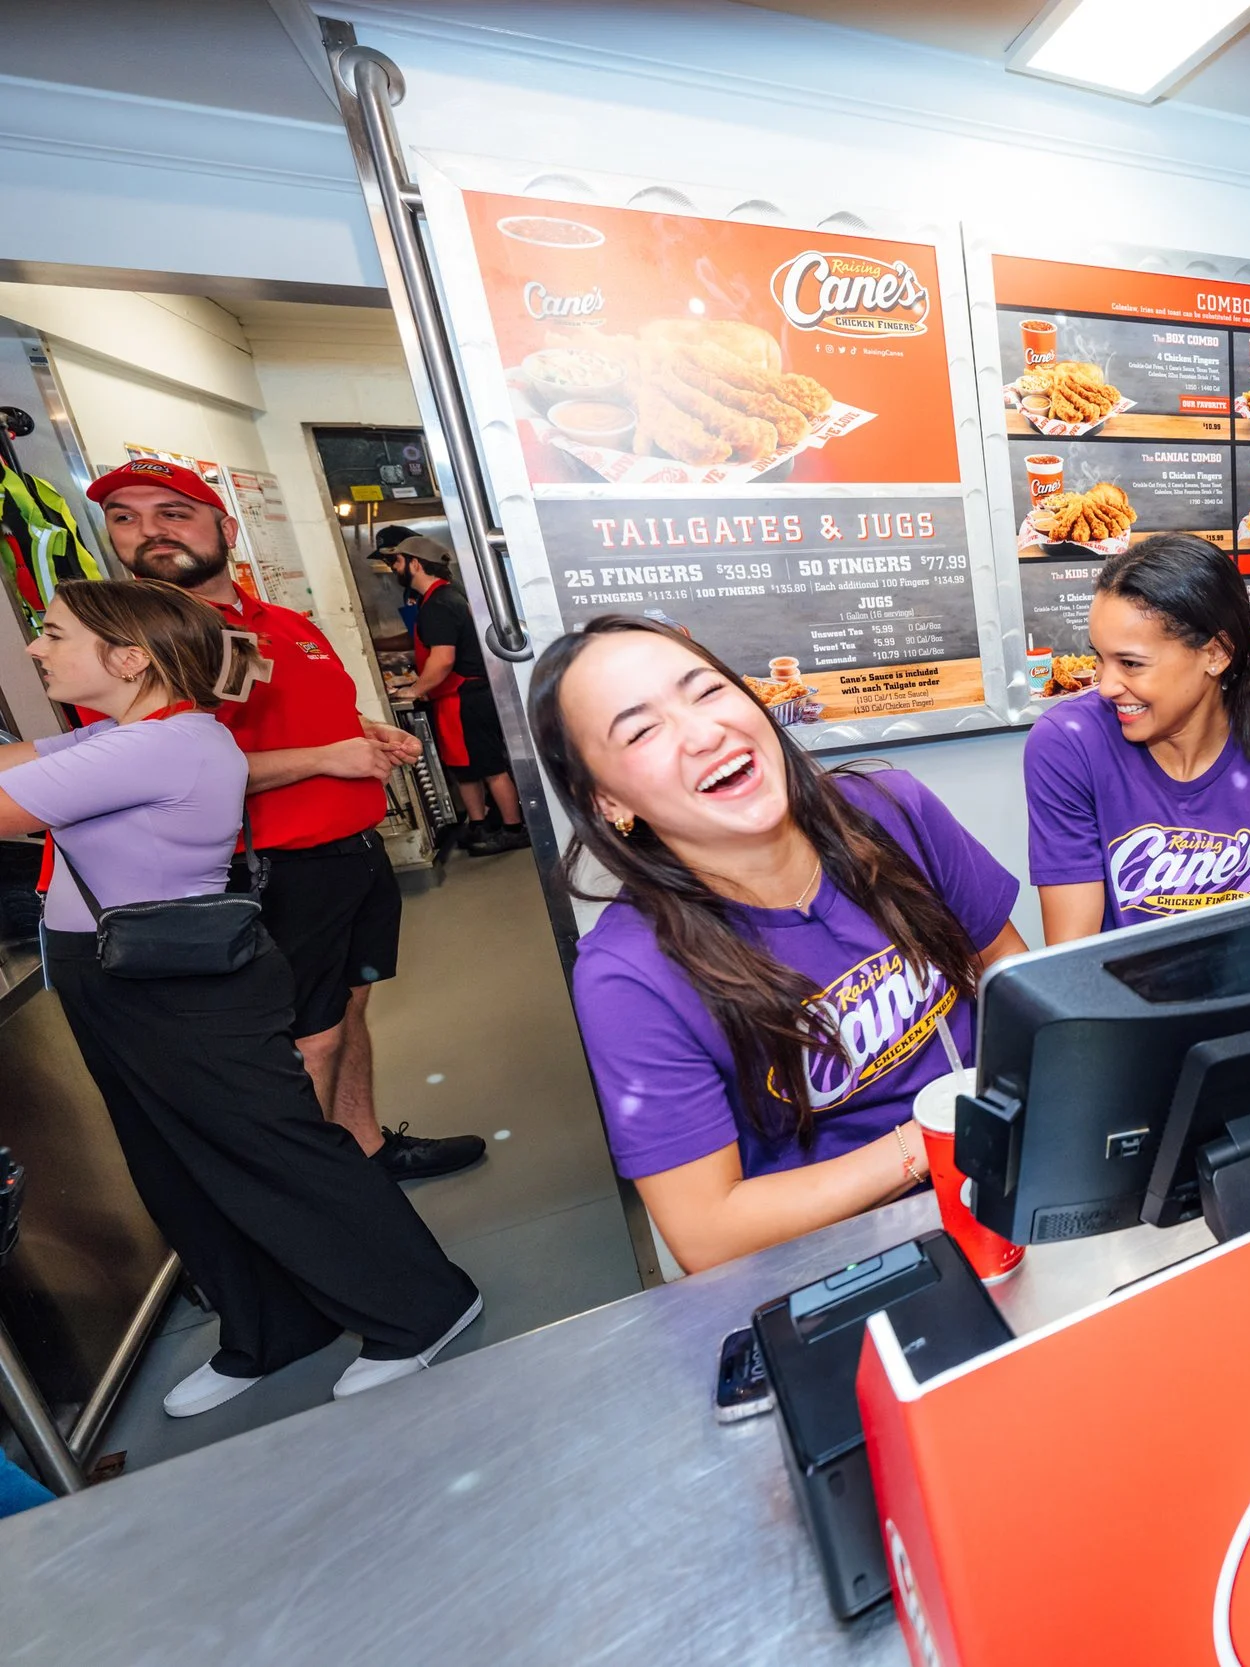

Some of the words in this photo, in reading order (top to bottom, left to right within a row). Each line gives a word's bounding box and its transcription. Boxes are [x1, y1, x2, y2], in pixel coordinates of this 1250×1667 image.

[832, 259, 881, 278] Raising
[783, 252, 926, 328] Cane's
[523, 281, 605, 320] Cane's
[1155, 307, 1166, 315] and
[1193, 310, 1201, 319] be
[835, 316, 874, 329] CHICKEN
[878, 320, 917, 332] FINGERS
[1152, 334, 1165, 342] The
[1165, 332, 1185, 345] BOX
[1187, 333, 1219, 347] COMBO
[1025, 348, 1056, 364] Cane's
[1157, 352, 1162, 361] 4
[1164, 352, 1192, 363] Chicken
[1193, 354, 1220, 366] Fingers
[1182, 401, 1196, 409] OUR
[1197, 401, 1227, 410] FAVORITE
[1141, 454, 1154, 462] The
[1154, 452, 1189, 463] CANIAC
[1191, 452, 1222, 463] COMBO
[1169, 471, 1196, 480] Chicken
[1197, 472, 1222, 482] Fingers
[1031, 479, 1061, 496] Cane's
[592, 515, 803, 549] TAILGATES
[820, 514, 844, 541] &
[857, 512, 936, 540] JUGS
[799, 559, 824, 577] 50
[828, 556, 912, 576] FINGERS
[920, 555, 967, 571] $77.99
[1051, 572, 1064, 580] The
[1064, 568, 1088, 579] KIDS
[564, 569, 595, 588] 25
[600, 564, 704, 587] FINGERS
[716, 563, 773, 581] $39.99
[815, 582, 836, 592] Each
[838, 580, 880, 590] additional
[881, 578, 898, 588] 100
[900, 577, 930, 588] Fingers
[934, 575, 965, 585] $134.99
[572, 595, 588, 605] 75
[591, 592, 644, 604] FINGERS
[648, 589, 688, 601] $113.16
[696, 588, 716, 599] 100
[718, 585, 766, 598] FINGERS
[771, 583, 807, 594] $135.80
[1059, 594, 1065, 602] 2
[857, 596, 894, 609] JUGS
[839, 613, 844, 621] 1
[846, 611, 869, 621] Gallon
[870, 610, 883, 620] (16
[883, 608, 915, 618] servings)
[810, 629, 847, 639] Unsweet
[848, 628, 864, 636] Tea
[871, 625, 894, 635] $5.99
[914, 622, 942, 631] Cal/8oz
[813, 643, 839, 652] Sweet
[840, 642, 856, 650] Tea
[873, 638, 896, 647] $5.99
[905, 637, 916, 645] 90
[916, 635, 944, 644] Cal/8oz
[815, 655, 857, 666] Lemonade
[873, 650, 900, 660] $10.79
[903, 649, 917, 658] 110
[918, 648, 945, 657] Cal/8oz
[840, 674, 867, 685] Cane's
[869, 671, 894, 681] Sauce
[895, 670, 903, 679] is
[905, 667, 939, 678] included
[841, 686, 860, 695] with
[862, 684, 882, 693] each
[883, 680, 916, 691] Tailgate
[918, 678, 940, 687] order
[874, 692, 906, 702] Cal/1.5oz
[907, 689, 929, 699] Sauce)
[853, 705, 870, 715] (130
[871, 701, 911, 712] Cal/Chicken
[912, 699, 934, 709] Finger)
[1169, 835, 1223, 855] Raising
[1157, 896, 1202, 906] CHICKEN
[835, 955, 903, 1012] Raising
[873, 1027, 923, 1070] CHICKEN
